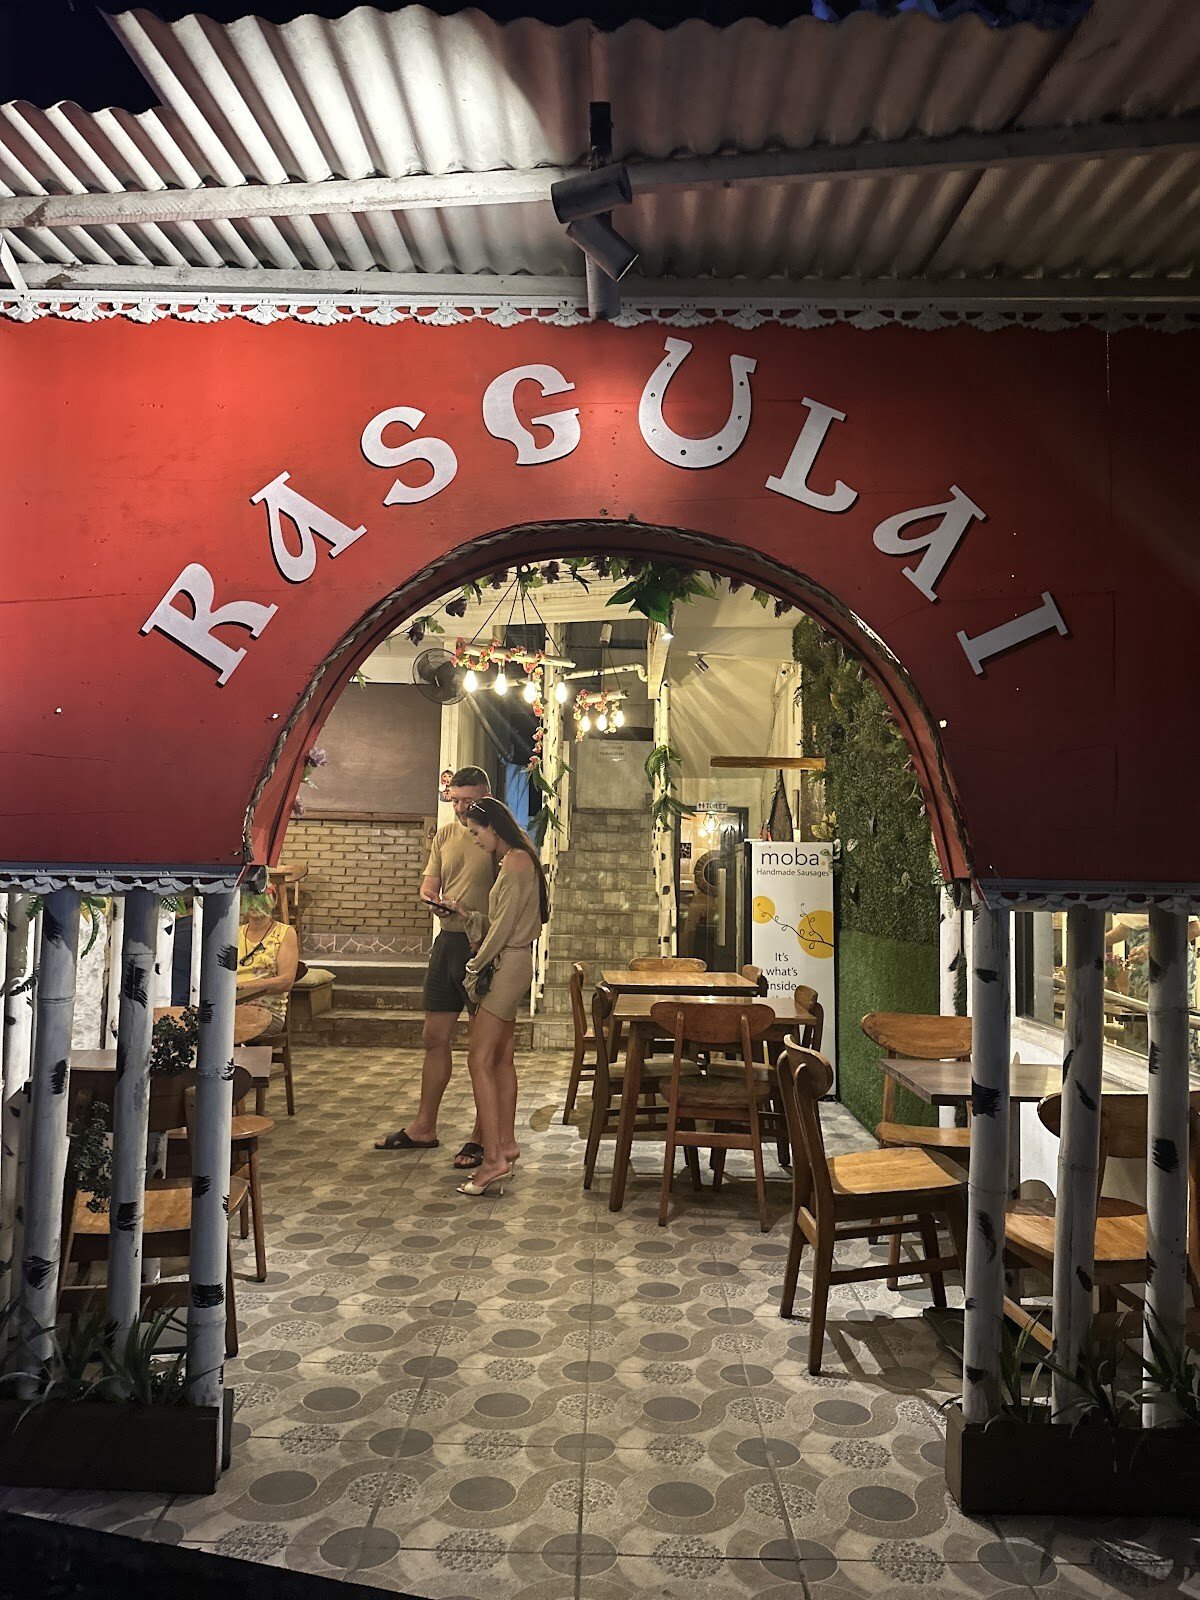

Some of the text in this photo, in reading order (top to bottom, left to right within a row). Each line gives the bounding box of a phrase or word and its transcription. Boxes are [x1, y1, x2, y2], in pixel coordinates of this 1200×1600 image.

[756, 868, 830, 878] Handmade Sausages
[775, 952, 789, 962] It's
[765, 966, 798, 977] what's
